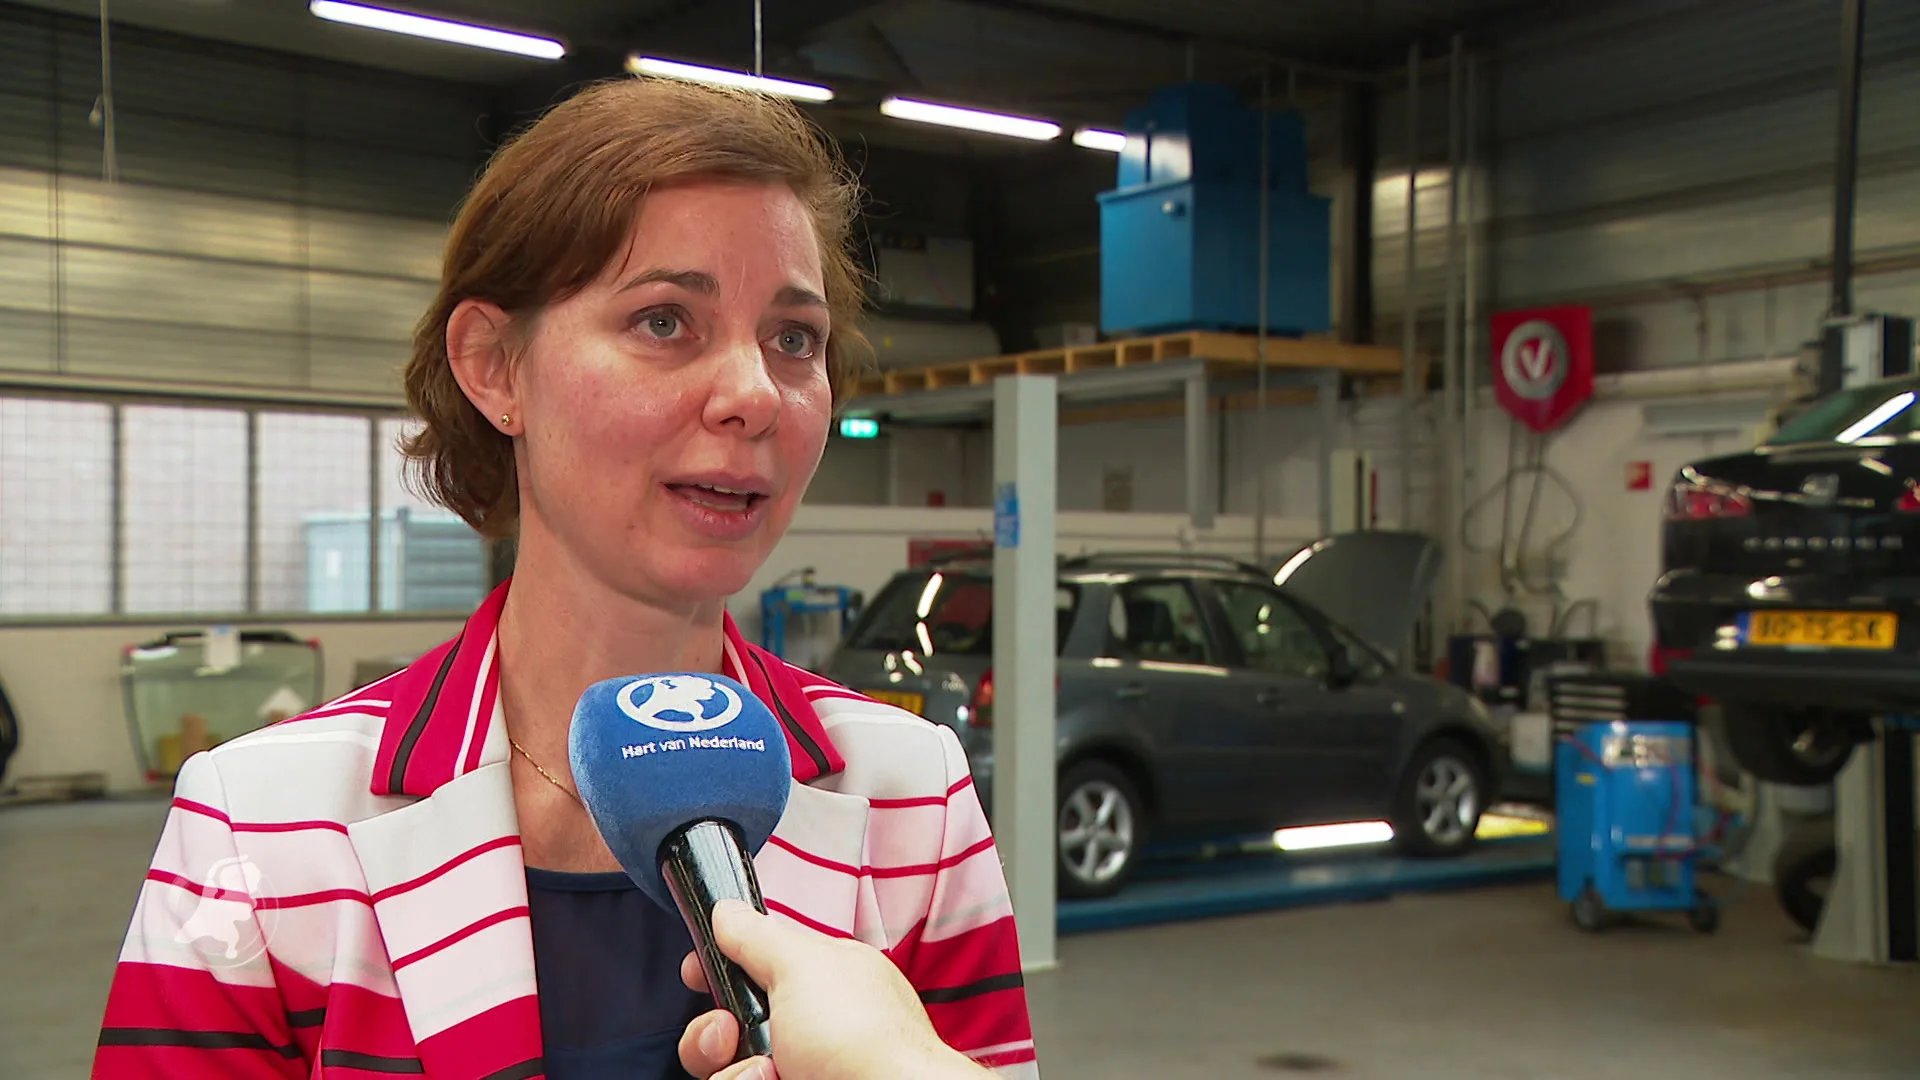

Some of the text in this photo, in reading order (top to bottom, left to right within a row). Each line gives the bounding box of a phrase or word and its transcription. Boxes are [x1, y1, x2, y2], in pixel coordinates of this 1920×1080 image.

[621, 736, 765, 759] Hart van Nederland
